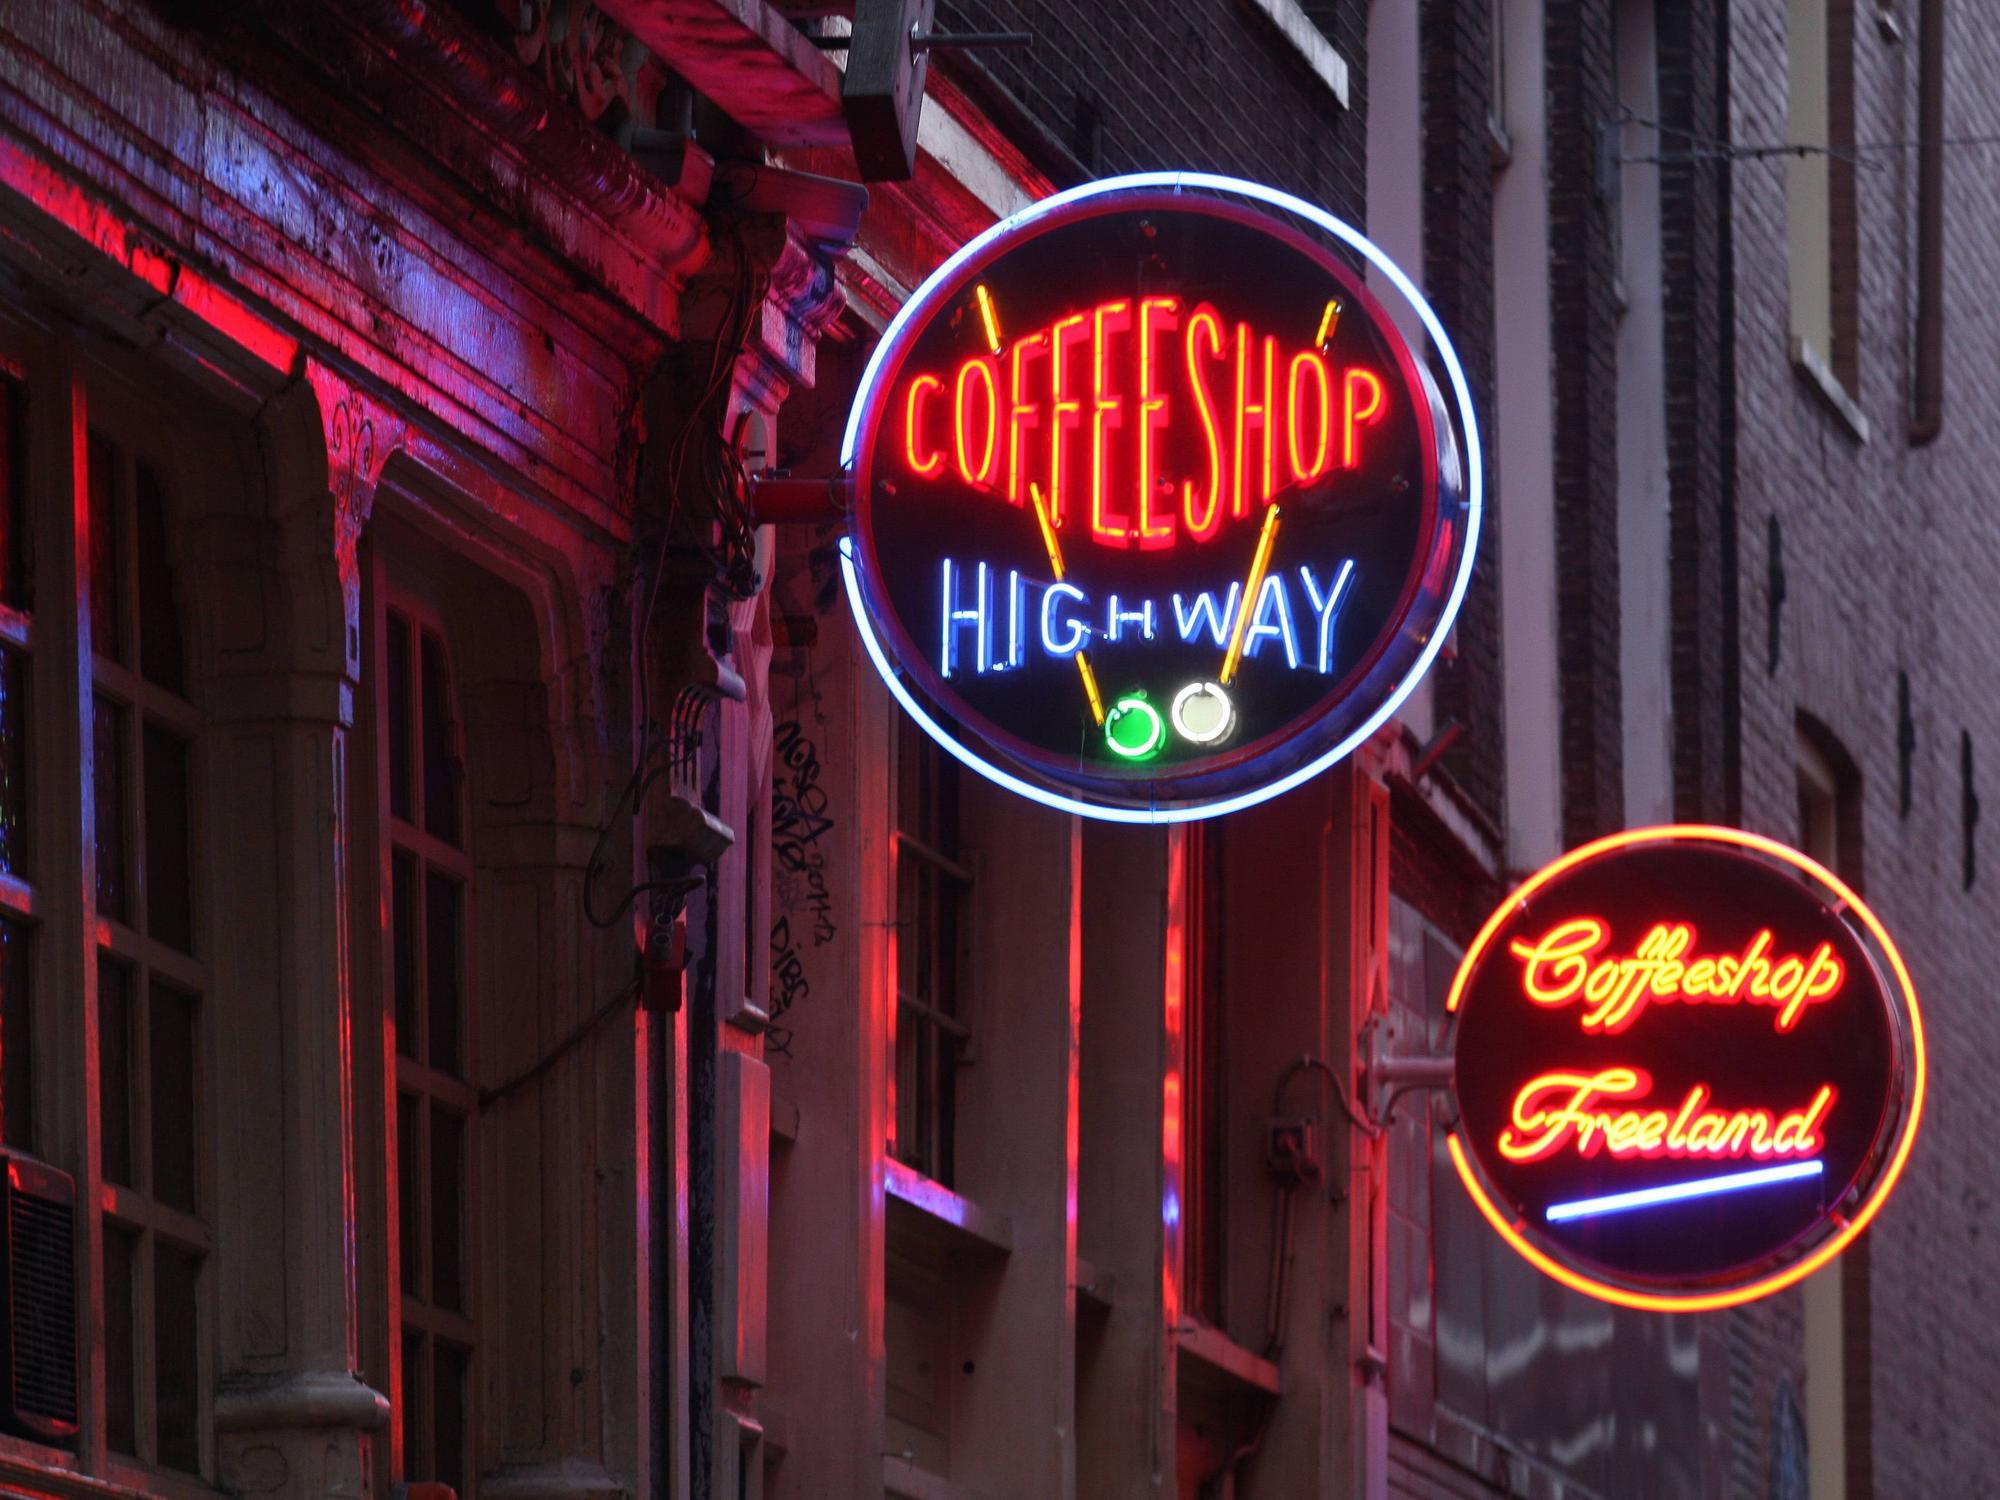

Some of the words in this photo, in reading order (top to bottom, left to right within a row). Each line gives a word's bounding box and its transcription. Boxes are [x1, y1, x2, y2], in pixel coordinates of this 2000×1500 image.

[905, 295, 1390, 549] COFFEESHOP
[941, 557, 1356, 678] HIGHWAY
[1509, 917, 1845, 1032] Coffeeshop
[1498, 1067, 1838, 1163] Freeland
